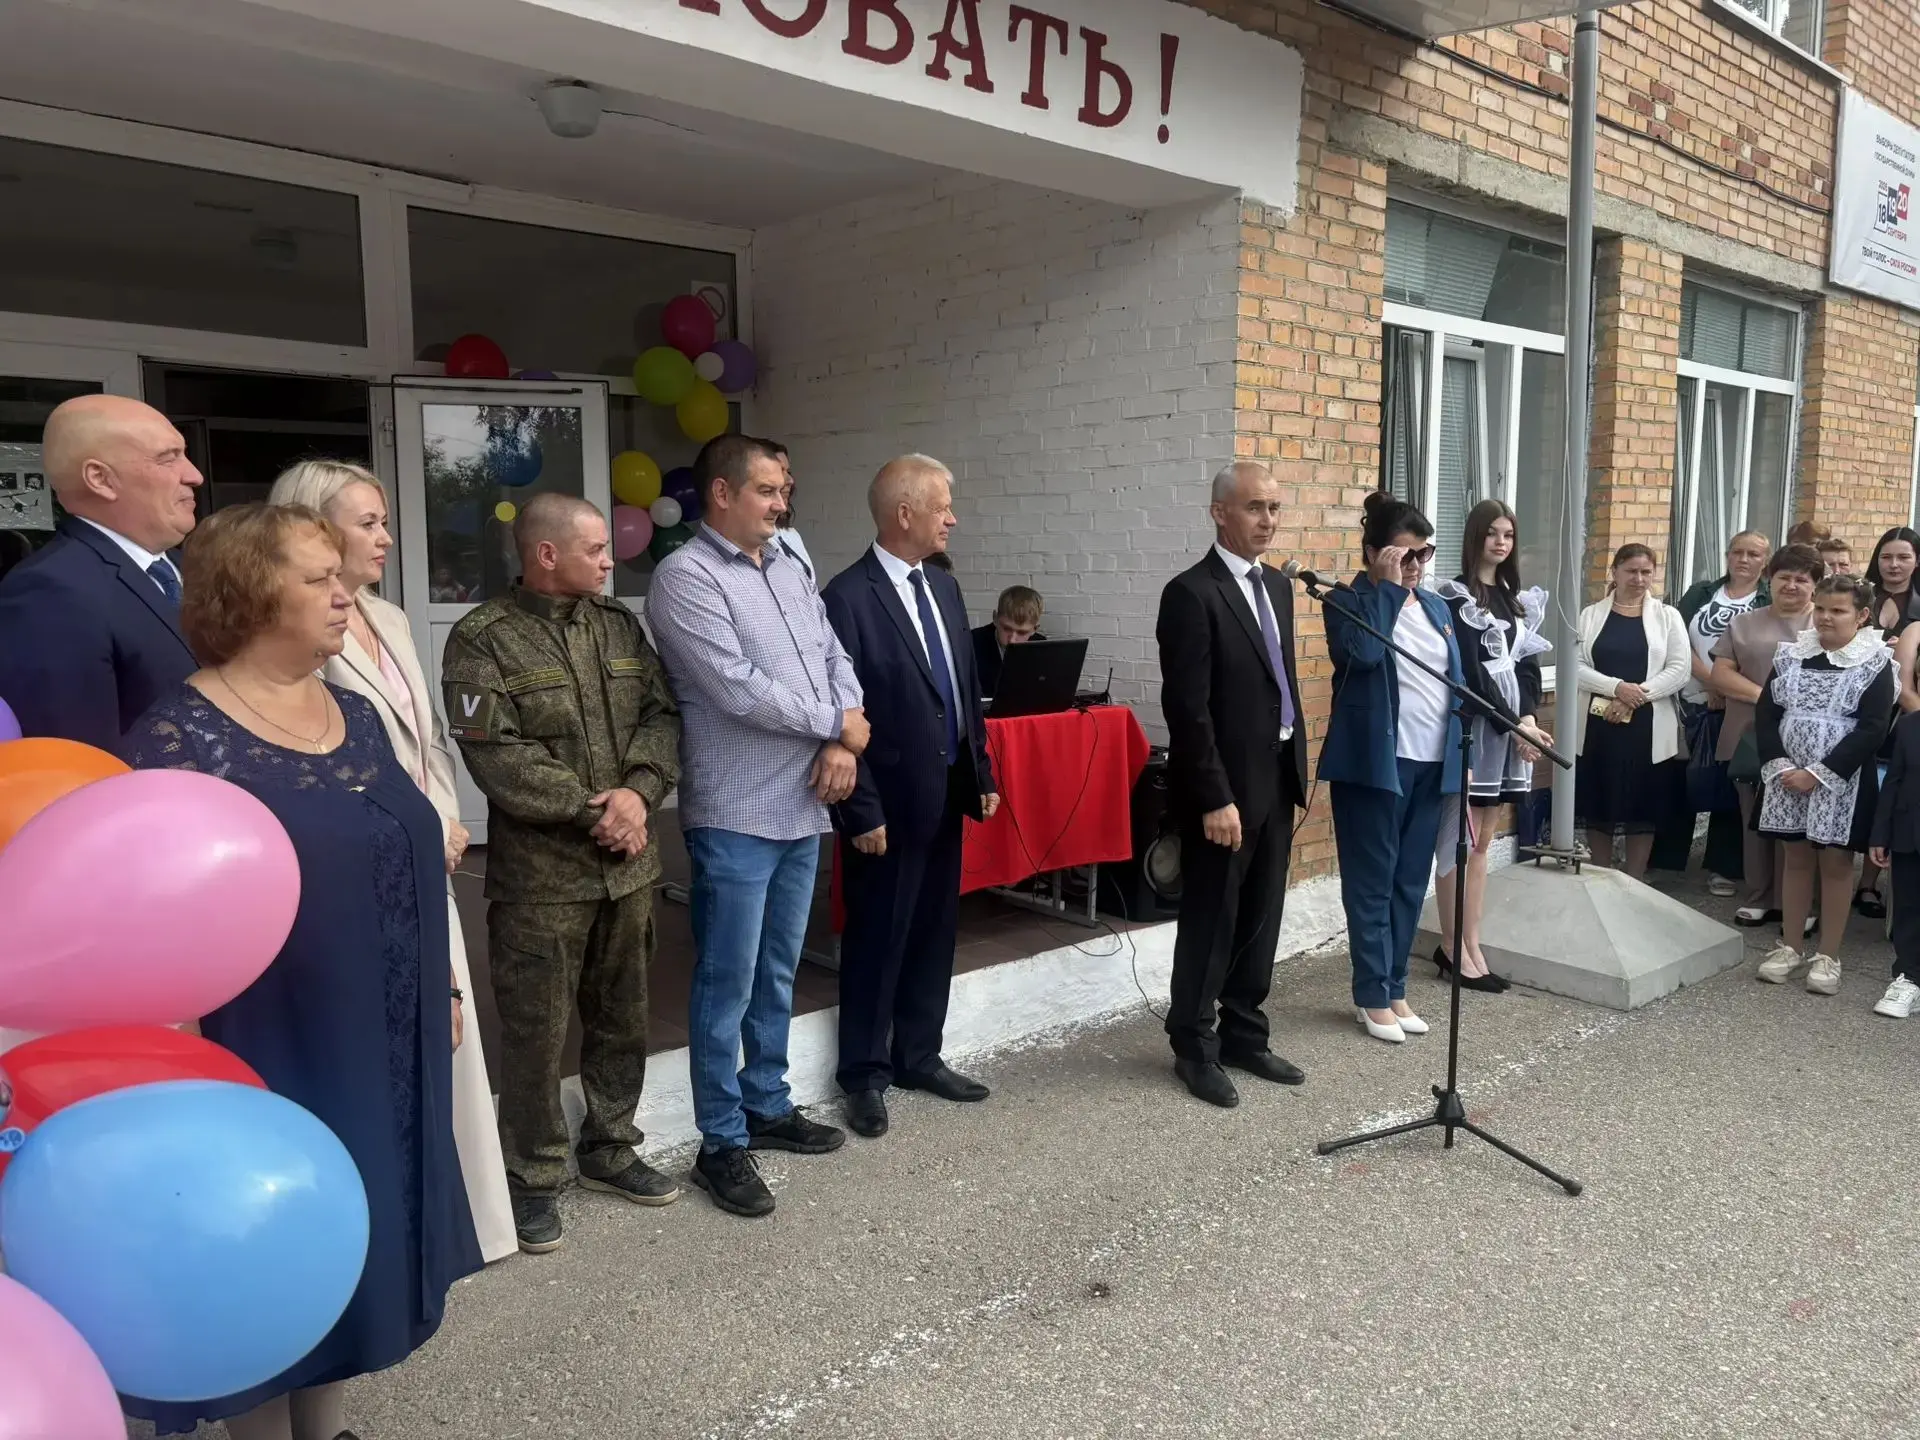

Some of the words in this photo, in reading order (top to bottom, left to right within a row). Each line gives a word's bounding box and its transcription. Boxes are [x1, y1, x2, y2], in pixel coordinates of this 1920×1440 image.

[679, 0, 1179, 145] ВАТЬ!
[1878, 203, 1886, 224] 18
[1888, 195, 1896, 218] 19
[1897, 190, 1907, 212] 20
[462, 693, 481, 718] V
